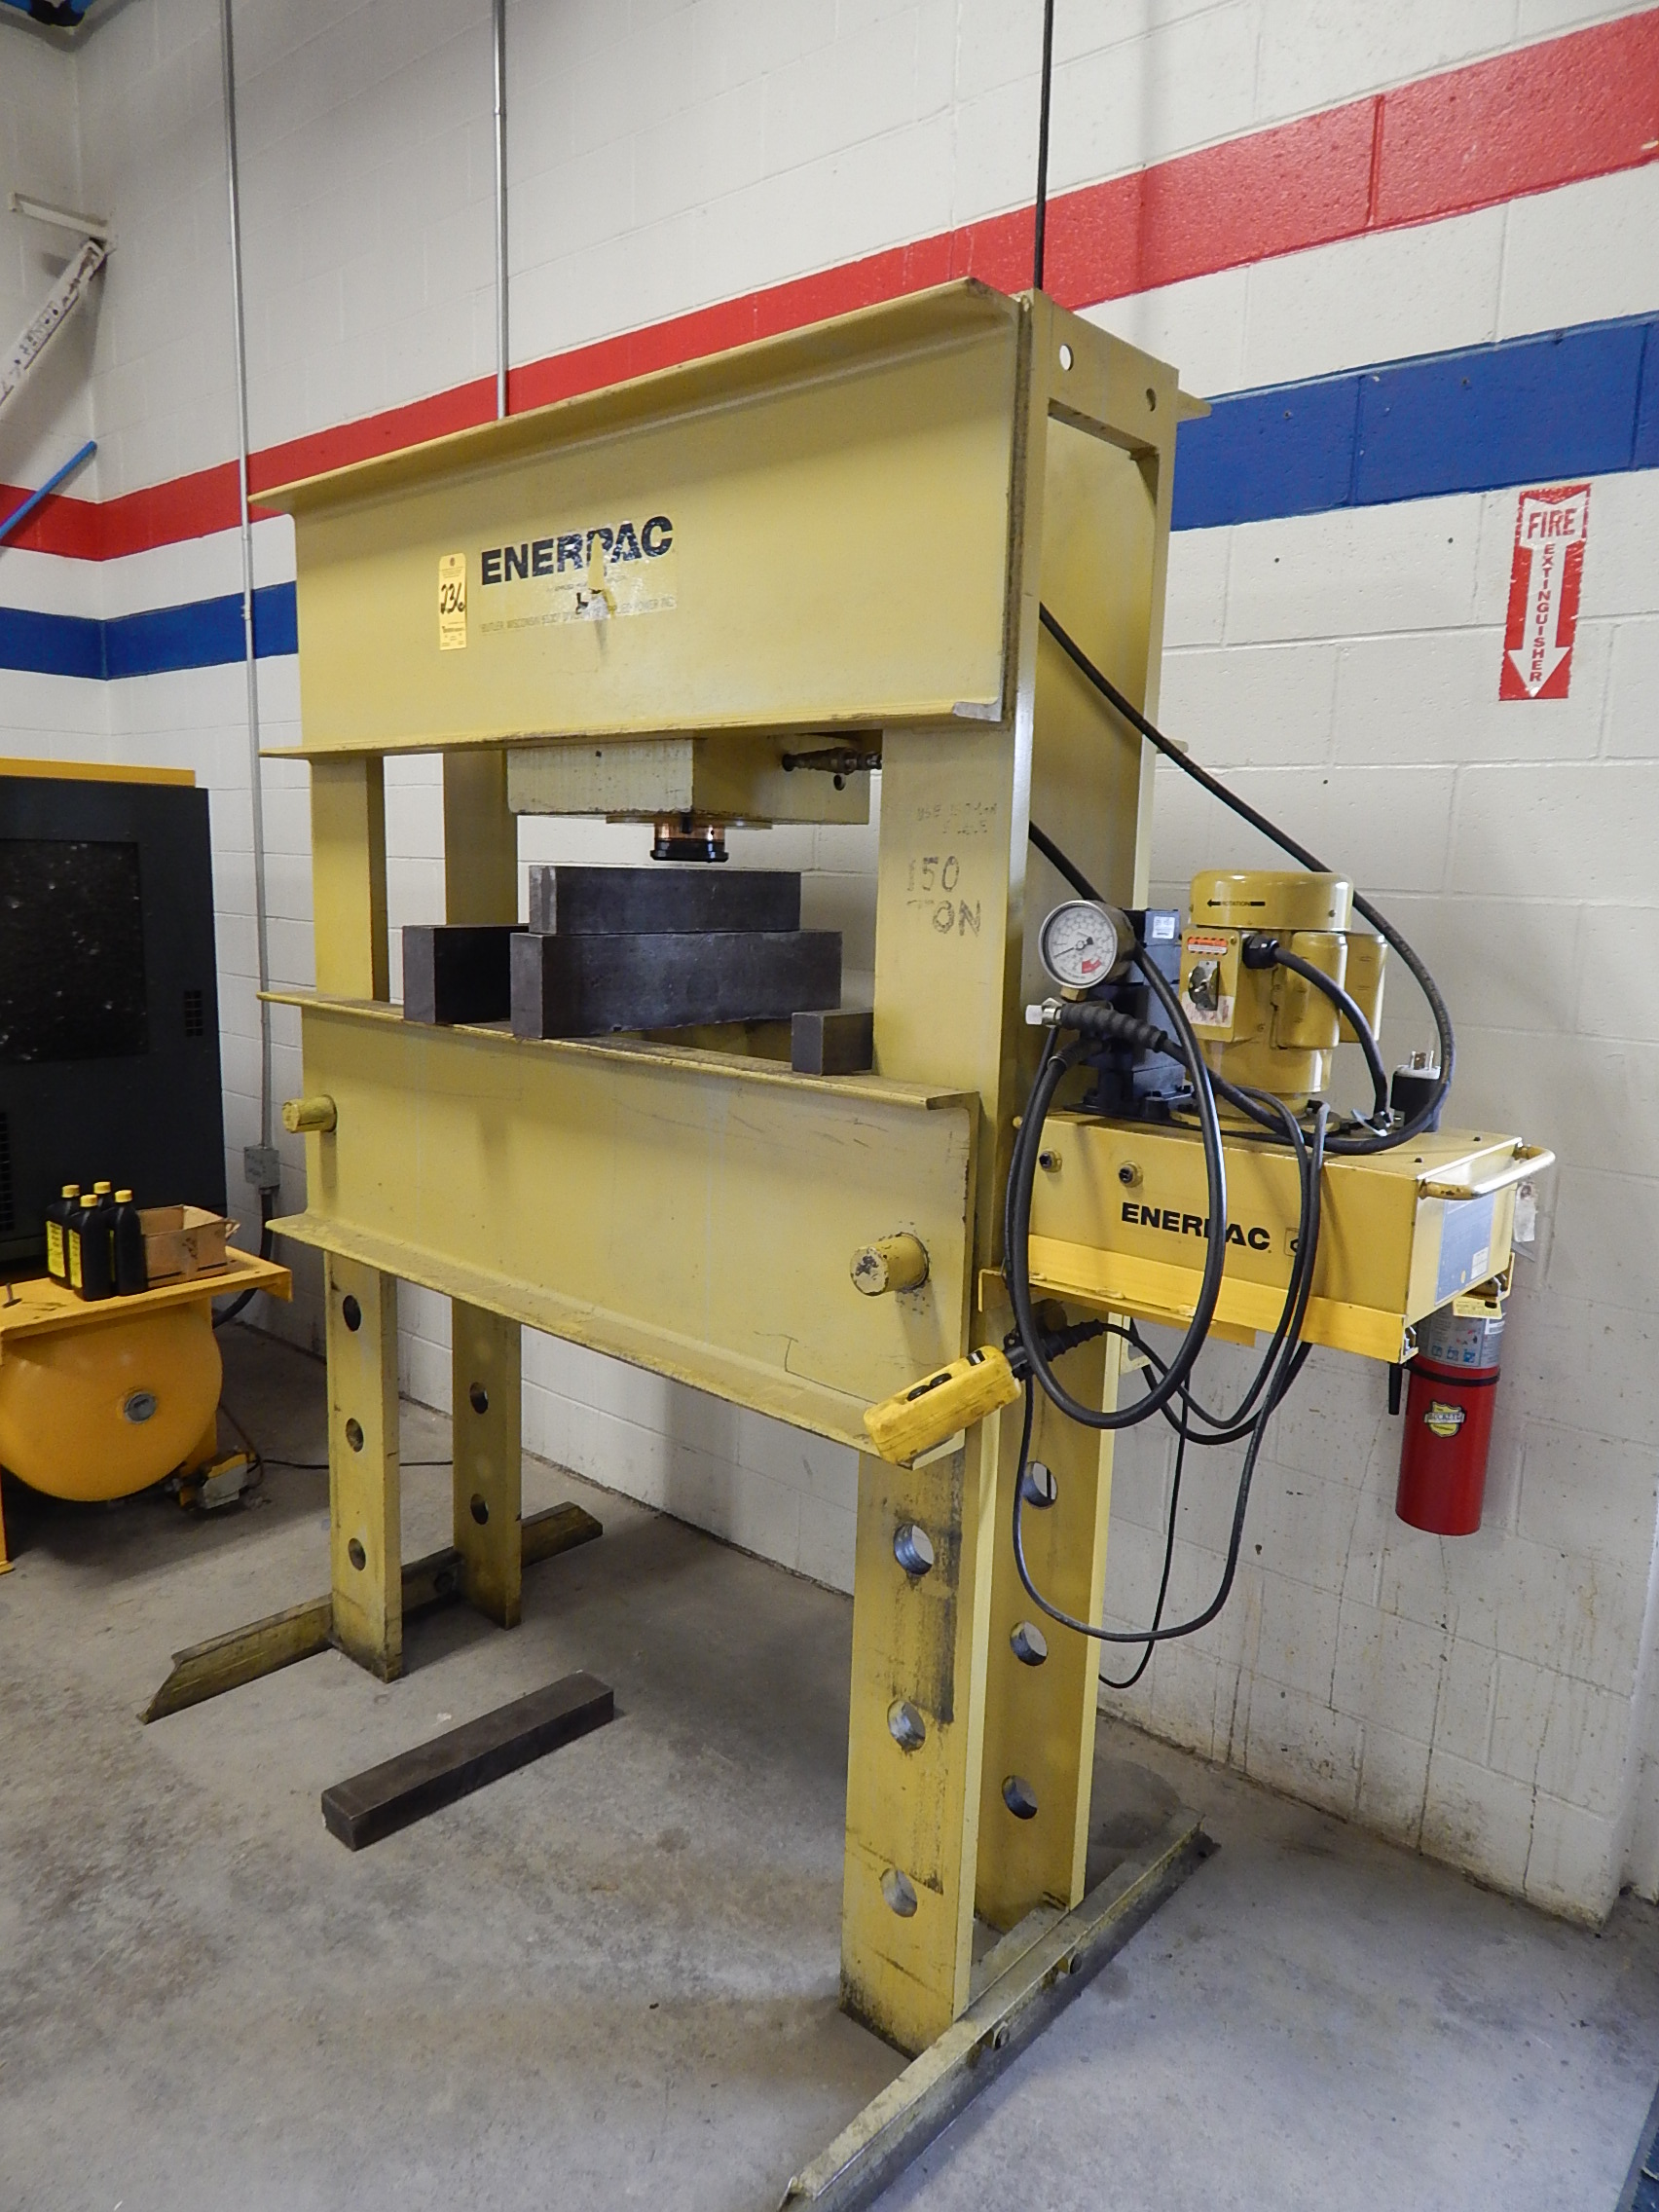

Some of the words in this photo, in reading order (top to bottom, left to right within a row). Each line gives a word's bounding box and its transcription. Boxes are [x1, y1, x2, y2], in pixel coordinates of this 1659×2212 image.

[1528, 507, 1578, 540] FIRE
[481, 516, 674, 586] ENERPAC
[440, 582, 465, 614] 236
[1529, 542, 1556, 682] EXTINGUISHER
[906, 855, 960, 893] 150
[1121, 1200, 1272, 1252] ENERAC
